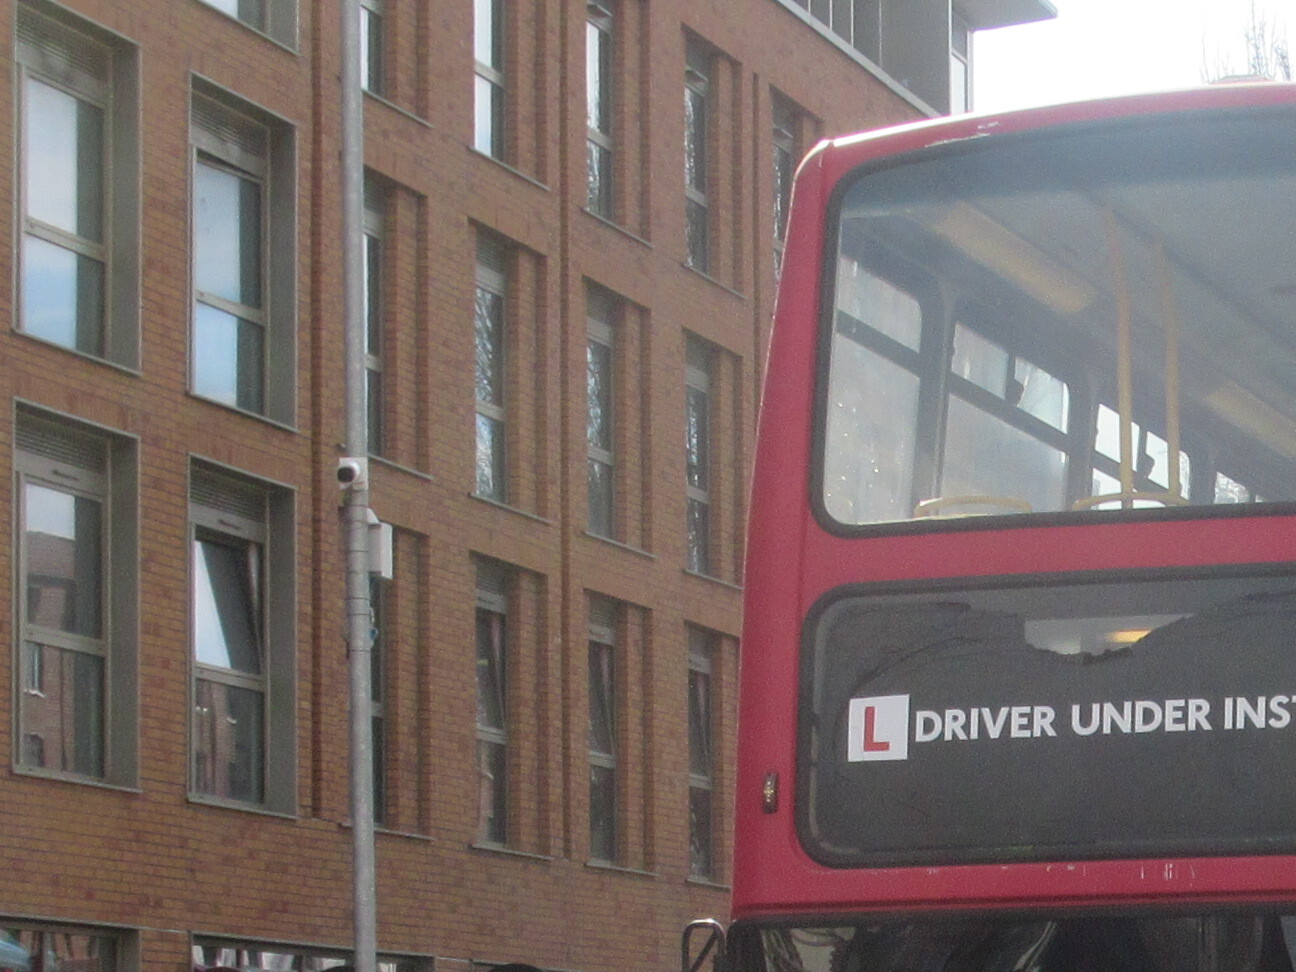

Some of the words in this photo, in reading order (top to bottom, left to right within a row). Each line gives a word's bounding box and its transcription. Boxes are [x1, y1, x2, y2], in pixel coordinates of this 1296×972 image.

[864, 707, 889, 751] L
[914, 705, 1057, 742] DRIVER
[1071, 699, 1212, 735] UNDER
